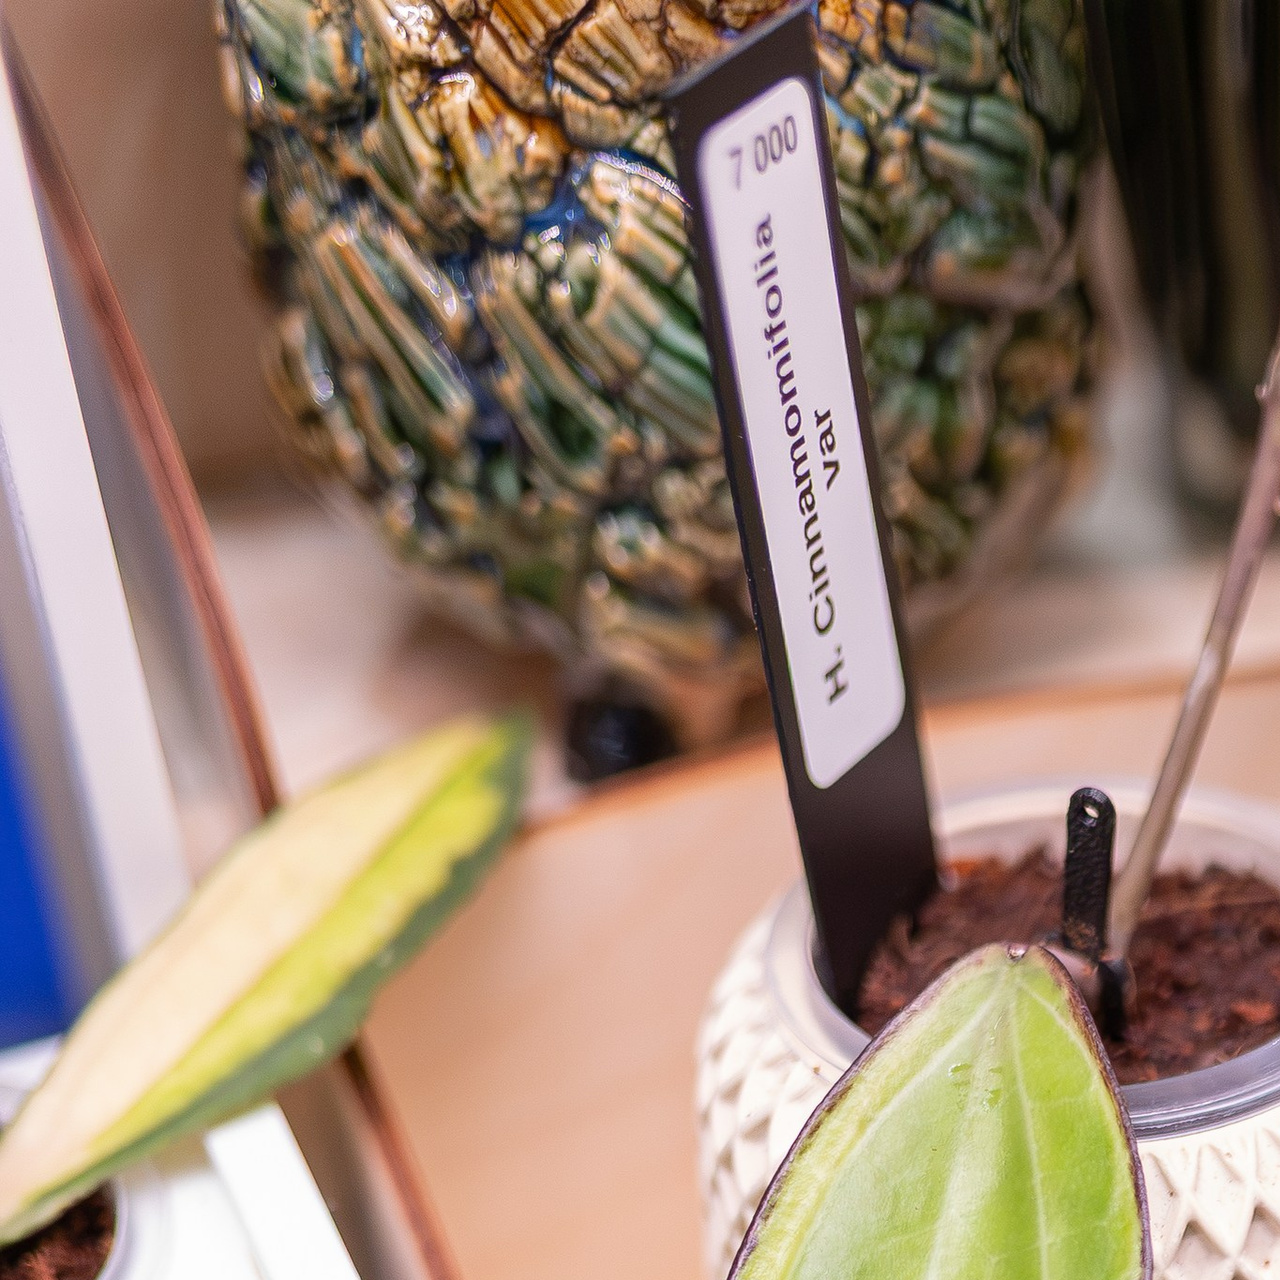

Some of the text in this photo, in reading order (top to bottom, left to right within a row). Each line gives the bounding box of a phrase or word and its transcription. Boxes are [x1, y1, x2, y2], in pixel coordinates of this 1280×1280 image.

[726, 113, 799, 190] 7 000
[755, 215, 849, 704] H. Cinnamomifolia
[813, 409, 841, 490] var
